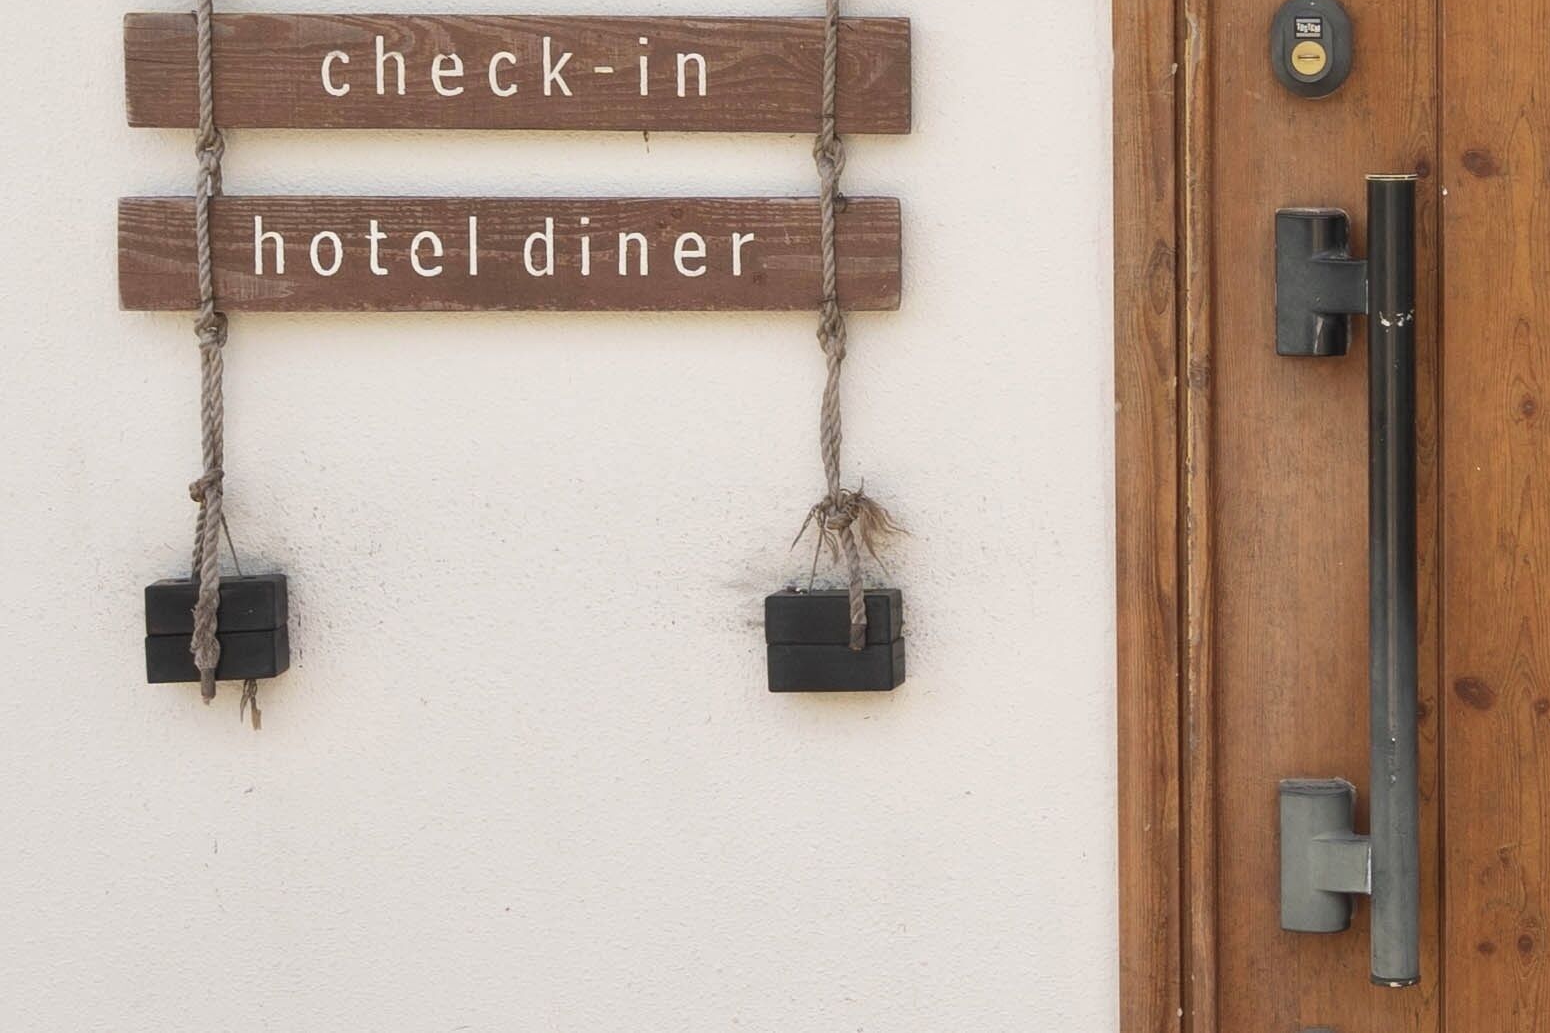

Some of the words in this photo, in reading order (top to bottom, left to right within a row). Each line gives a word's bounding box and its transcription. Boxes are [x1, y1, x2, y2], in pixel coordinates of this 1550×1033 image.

[321, 35, 707, 98] check-in
[254, 215, 478, 277] hotel
[523, 216, 755, 277] diner
